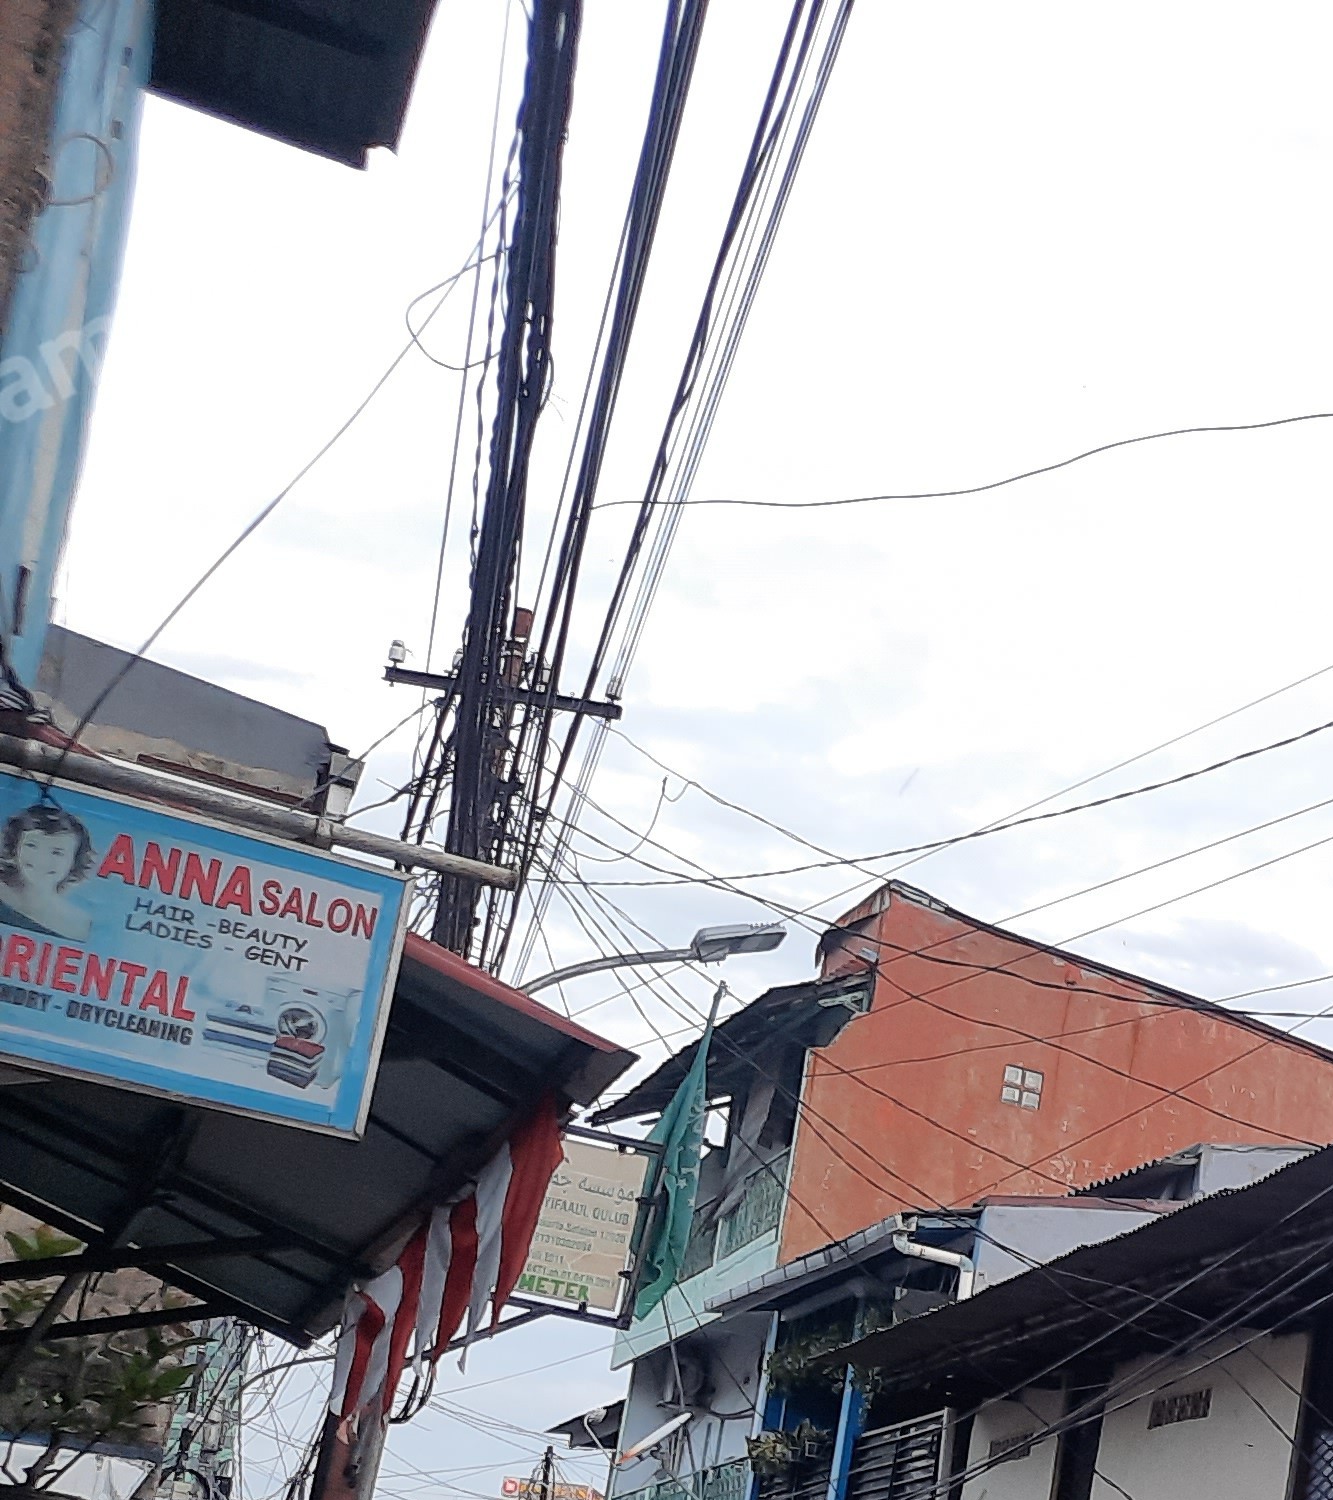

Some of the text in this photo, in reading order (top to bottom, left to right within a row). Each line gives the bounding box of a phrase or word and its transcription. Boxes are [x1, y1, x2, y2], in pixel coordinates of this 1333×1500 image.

[97, 833, 379, 940] ANNA SALON
[135, 897, 195, 925] HAIR
[125, 914, 213, 949] LADIES
[244, 945, 309, 972] GENT
[0, 934, 196, 1021] RIENTAL
[66, 1000, 193, 1046] DRYCLEANING
[518, 1273, 590, 1301] METER
